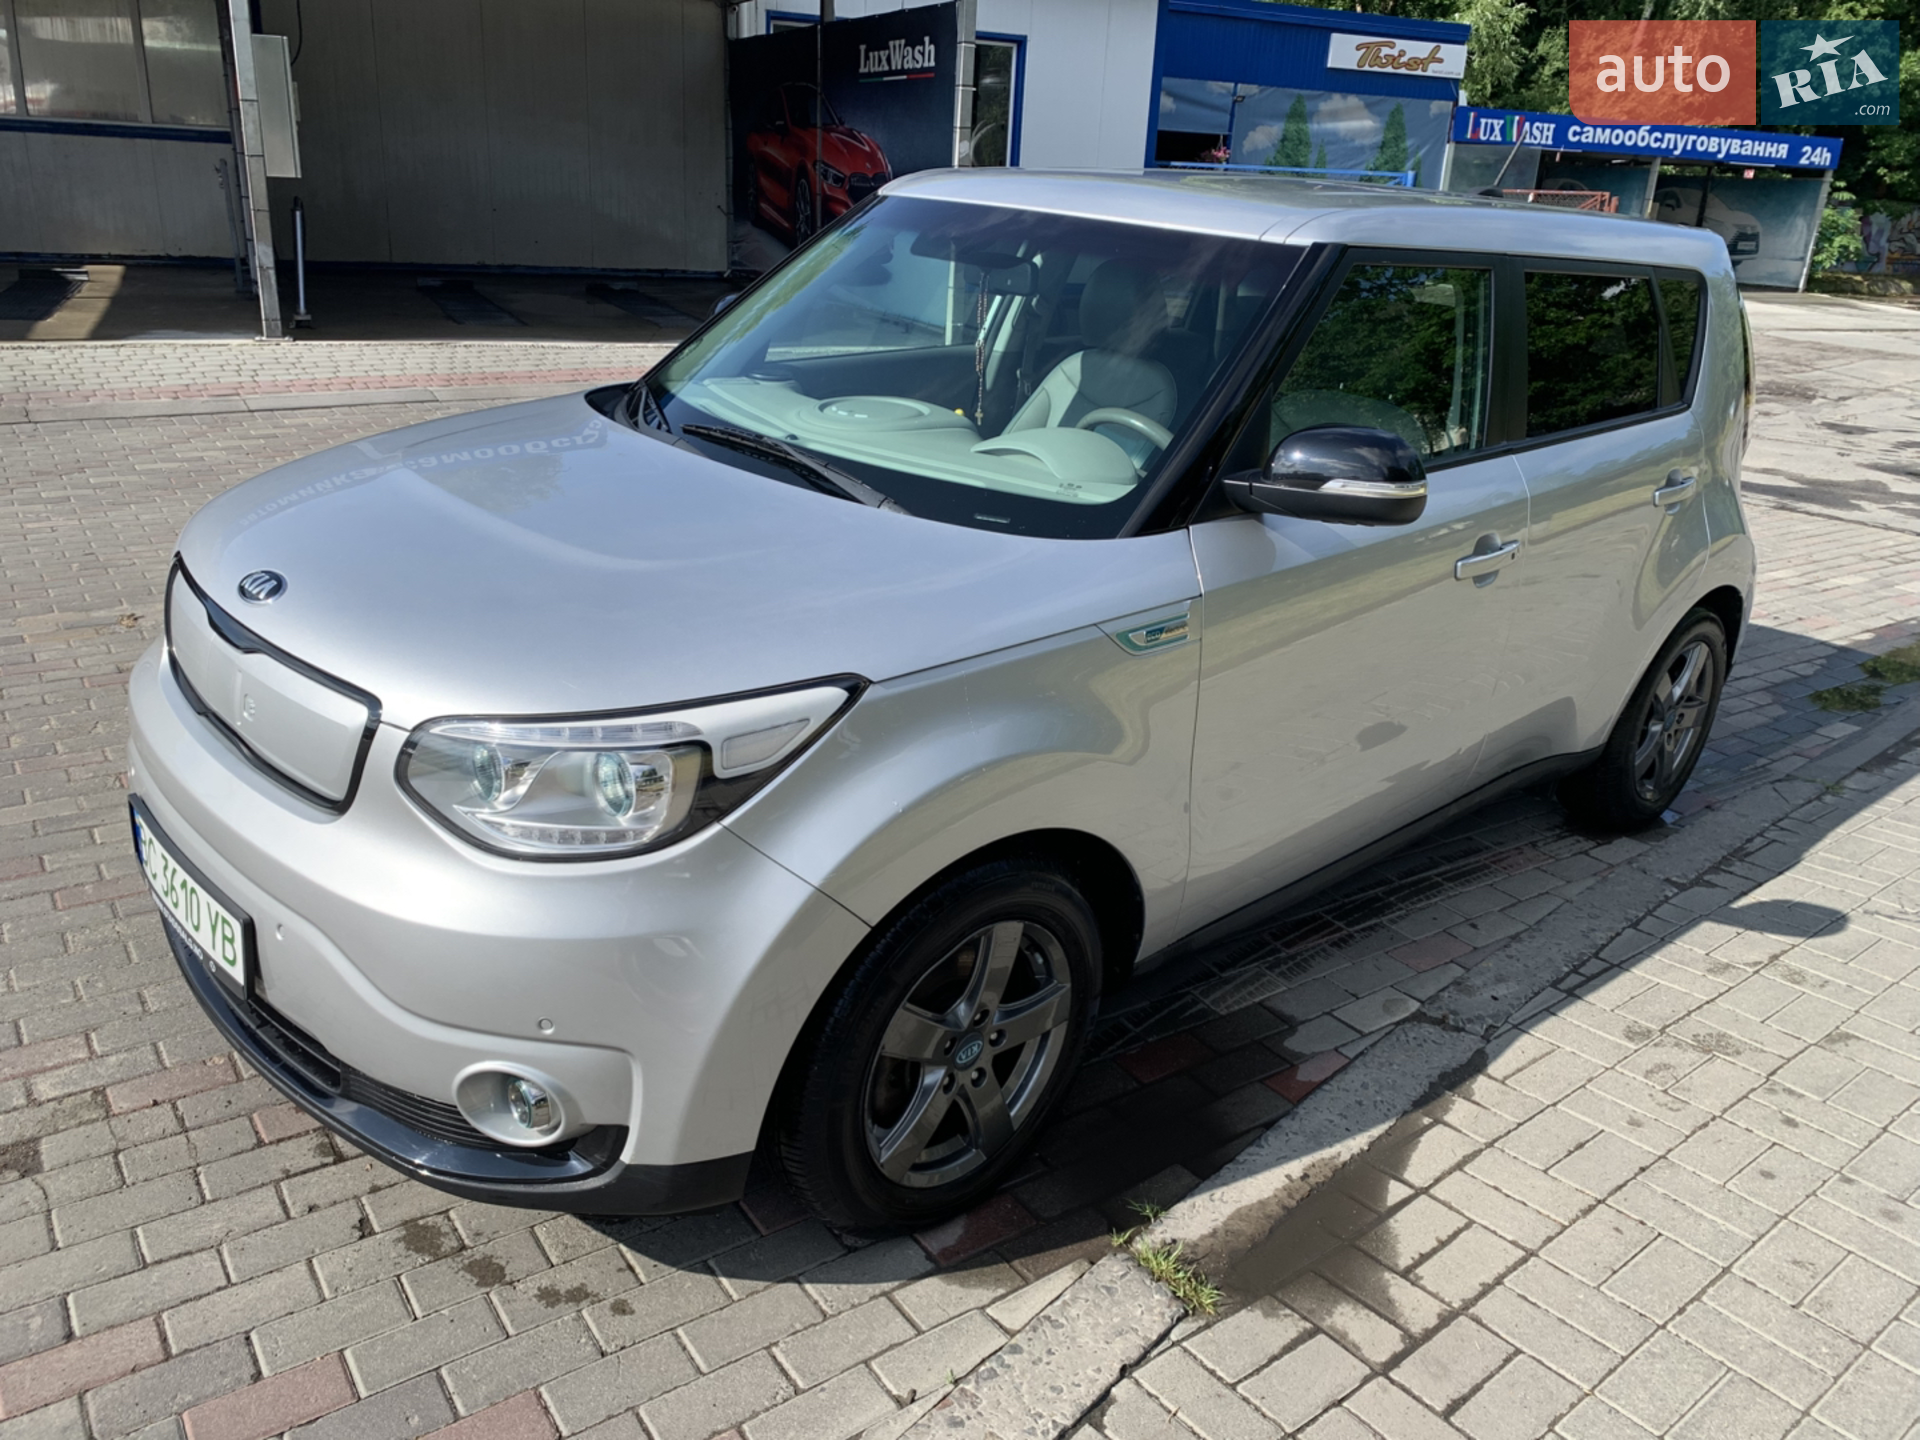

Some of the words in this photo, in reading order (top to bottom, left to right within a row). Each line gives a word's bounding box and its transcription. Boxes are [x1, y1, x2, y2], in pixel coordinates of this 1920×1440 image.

[858, 36, 936, 73] LuxWash
[1355, 40, 1444, 72] Twist
[1567, 124, 1789, 160] самообслуговування
[1799, 145, 1832, 166] 24h
[160, 851, 200, 933] 3610
[206, 901, 237, 967] YB
